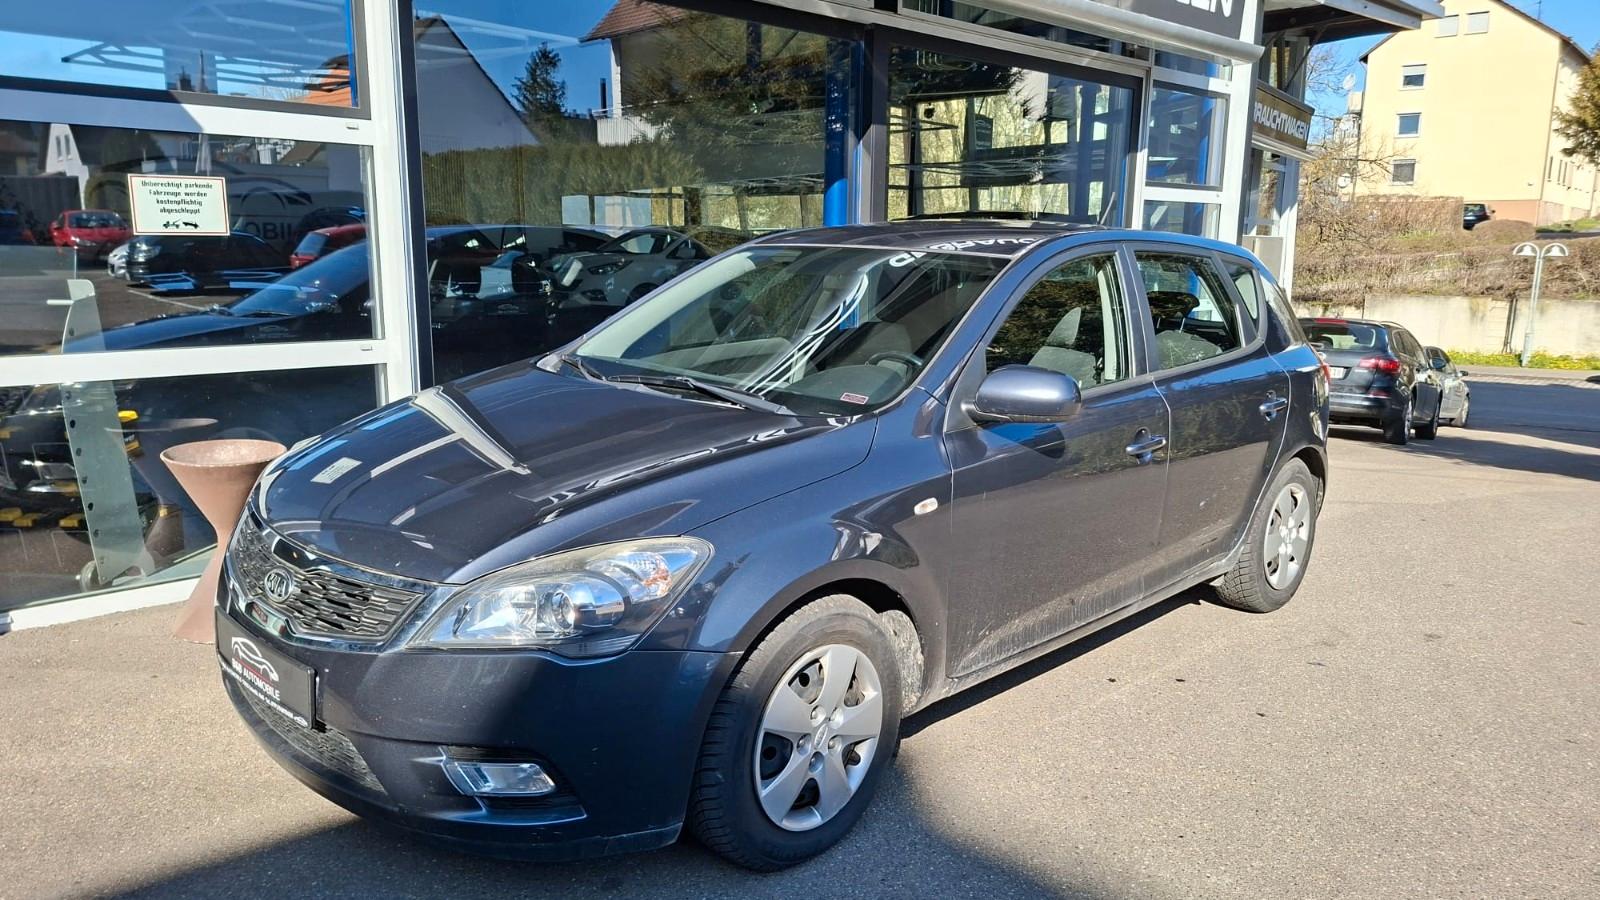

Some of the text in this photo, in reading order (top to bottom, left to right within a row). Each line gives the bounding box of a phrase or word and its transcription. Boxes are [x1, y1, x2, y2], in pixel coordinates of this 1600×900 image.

[141, 180, 182, 189] Unberechtigt
[149, 189, 181, 197] Fahrzeuge
[156, 198, 202, 206] kostenpflichtig
[159, 207, 200, 215] abgeschleppt
[243, 666, 281, 701] AUTOMOBILE
